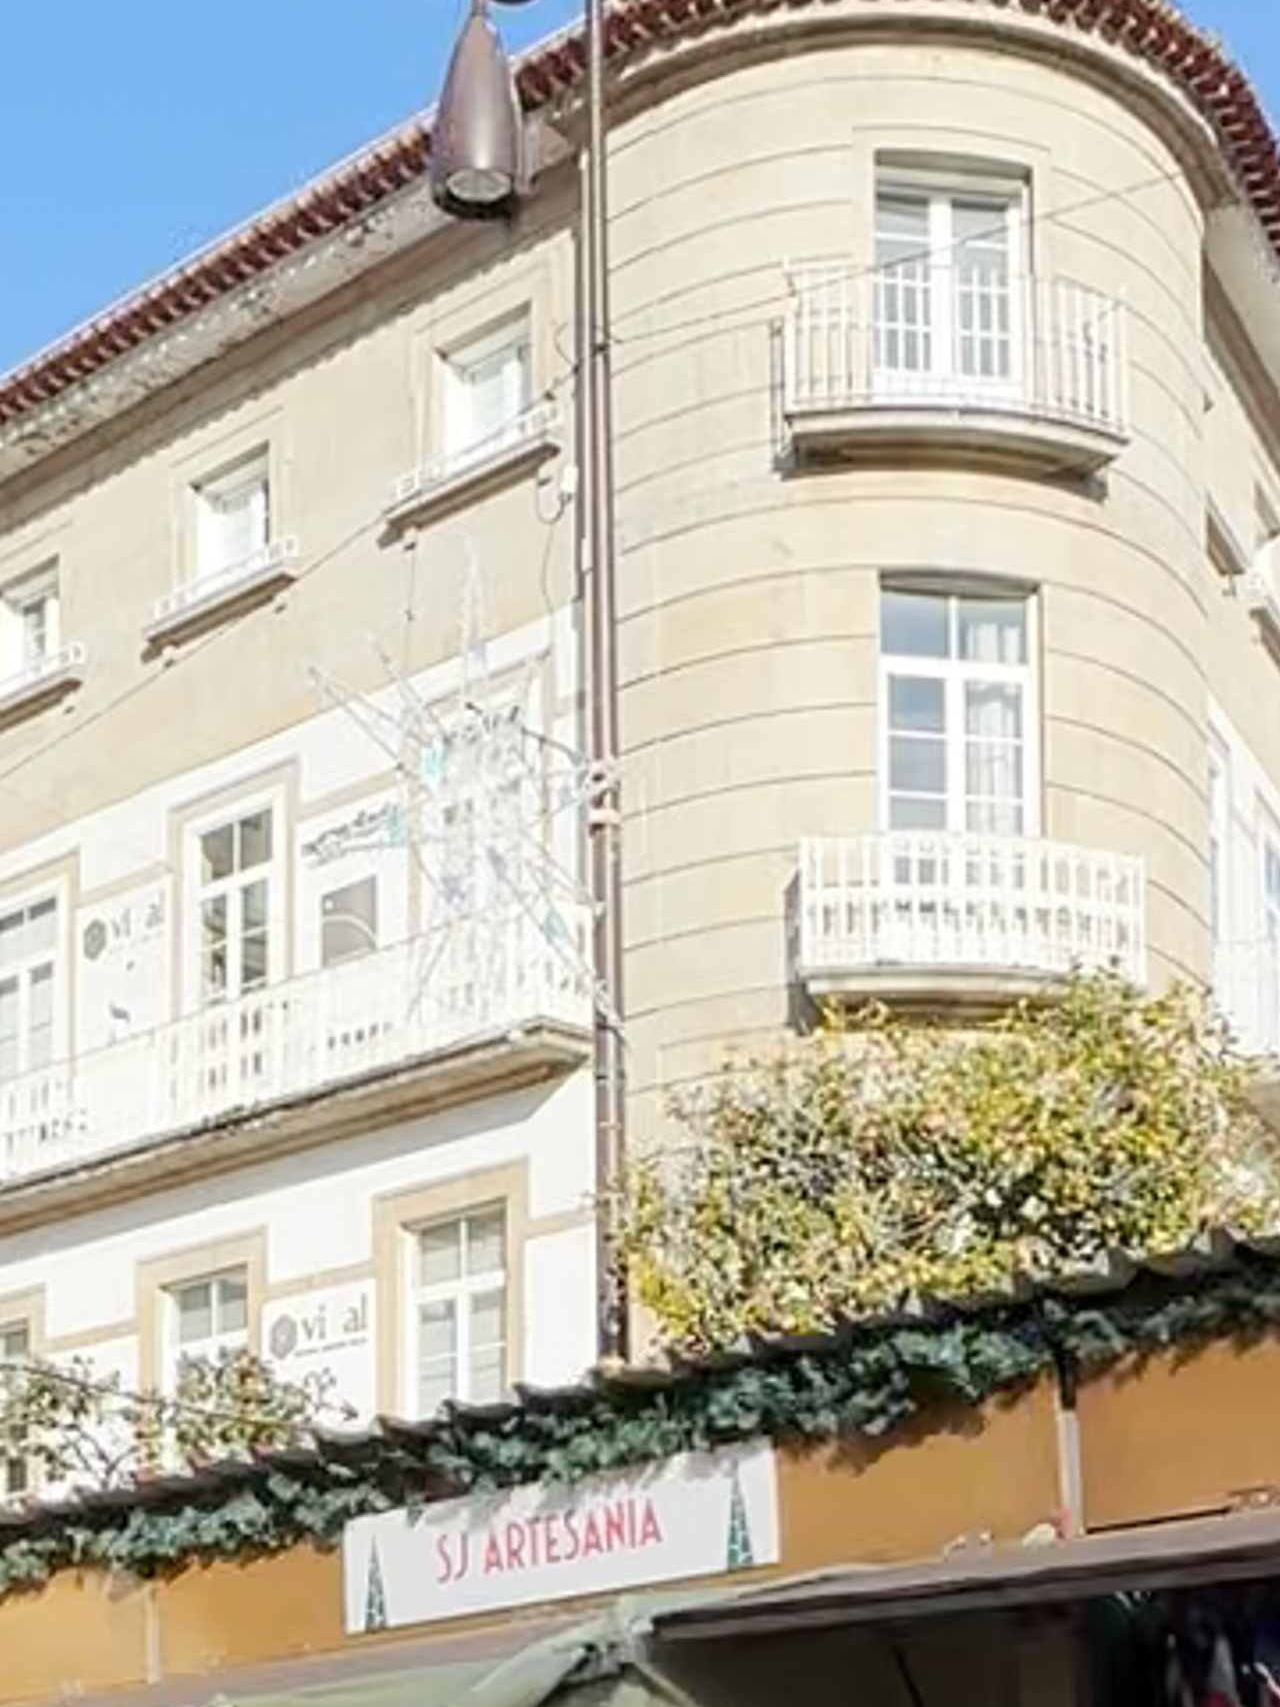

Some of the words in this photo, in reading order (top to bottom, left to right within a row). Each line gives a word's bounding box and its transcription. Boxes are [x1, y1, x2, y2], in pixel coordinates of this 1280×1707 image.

[301, 1293, 368, 1341] vial
[436, 1532, 469, 1584] SJ
[483, 1498, 663, 1574] ARTESANIA
